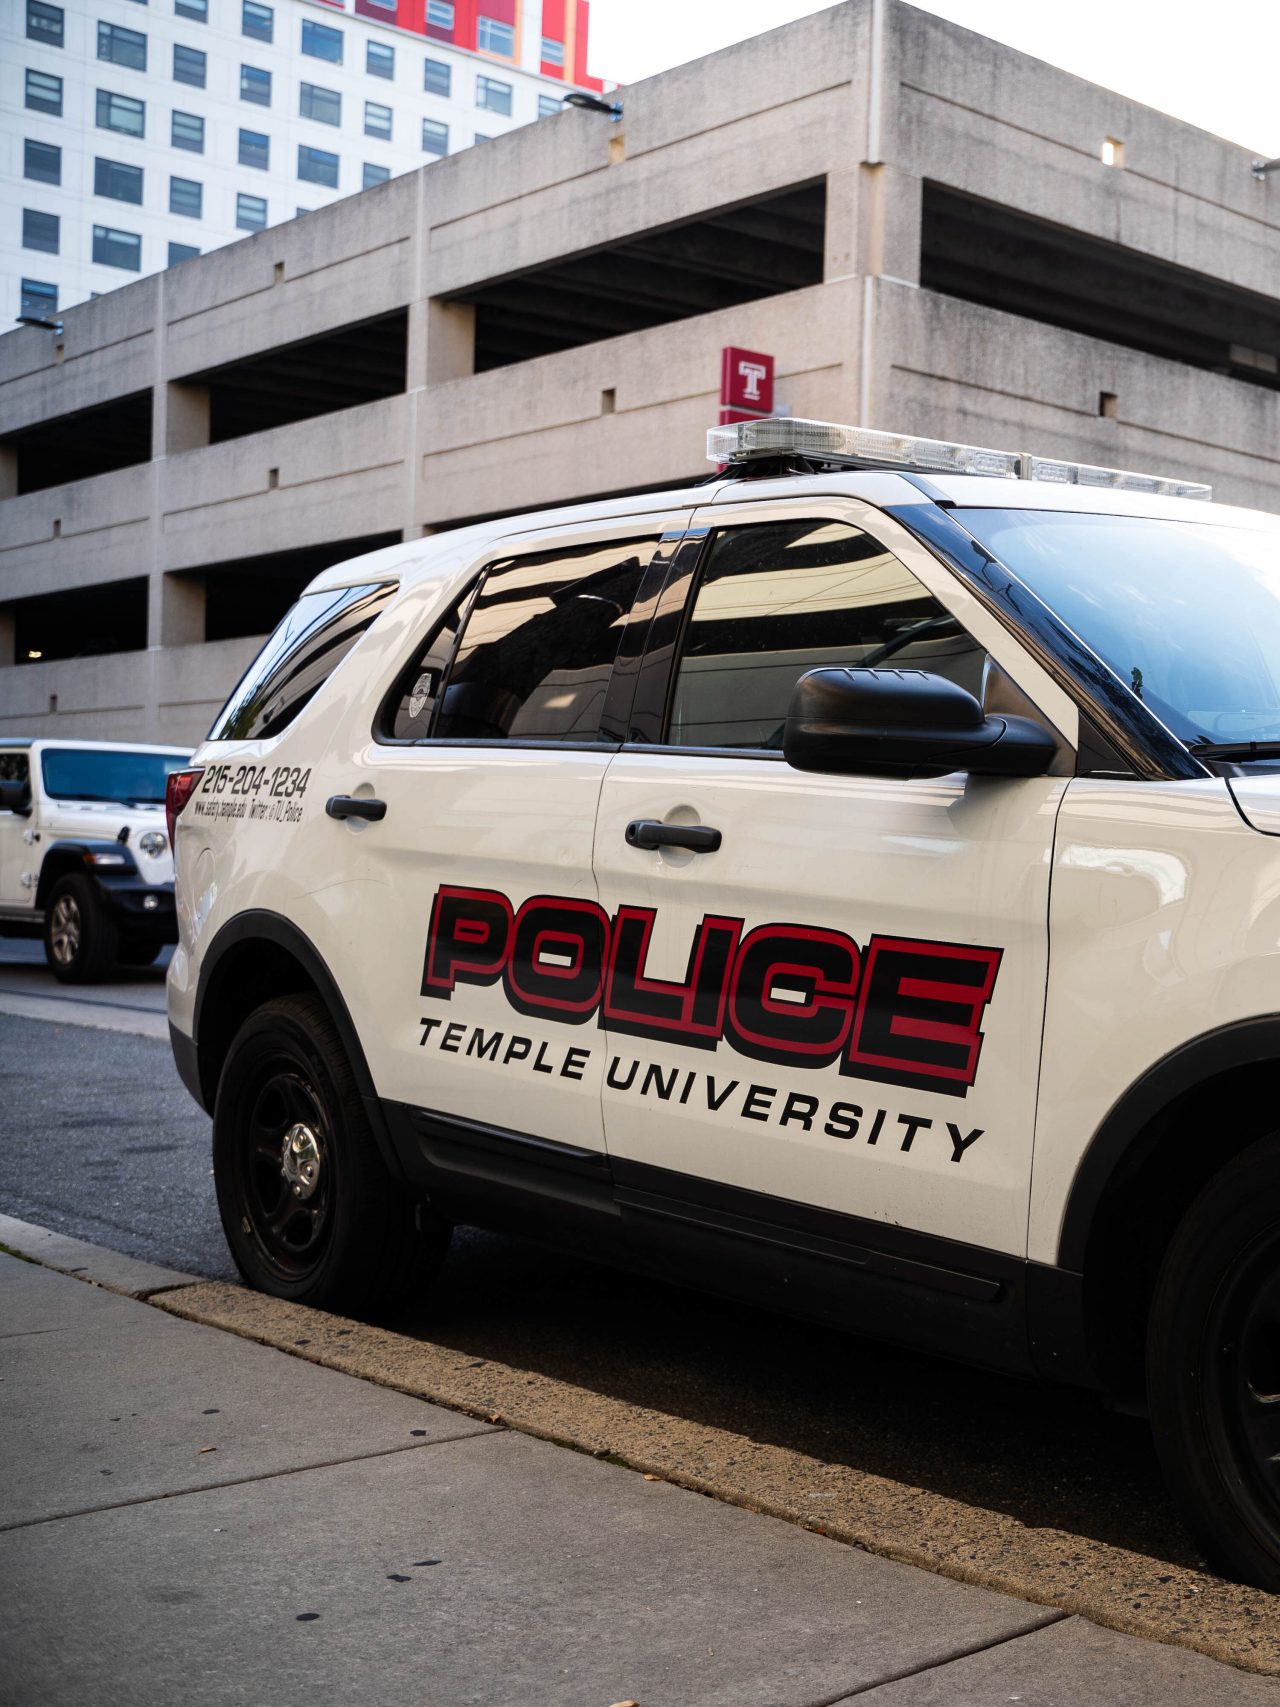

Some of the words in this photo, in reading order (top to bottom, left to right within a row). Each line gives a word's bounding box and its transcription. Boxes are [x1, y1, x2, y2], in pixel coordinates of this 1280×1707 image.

[738, 361, 766, 400] T
[202, 765, 312, 798] 215-204-1234
[420, 883, 1005, 1098] POLICE
[418, 1017, 591, 1080] TEMPLE
[606, 1055, 985, 1163] UNIVERSITY
